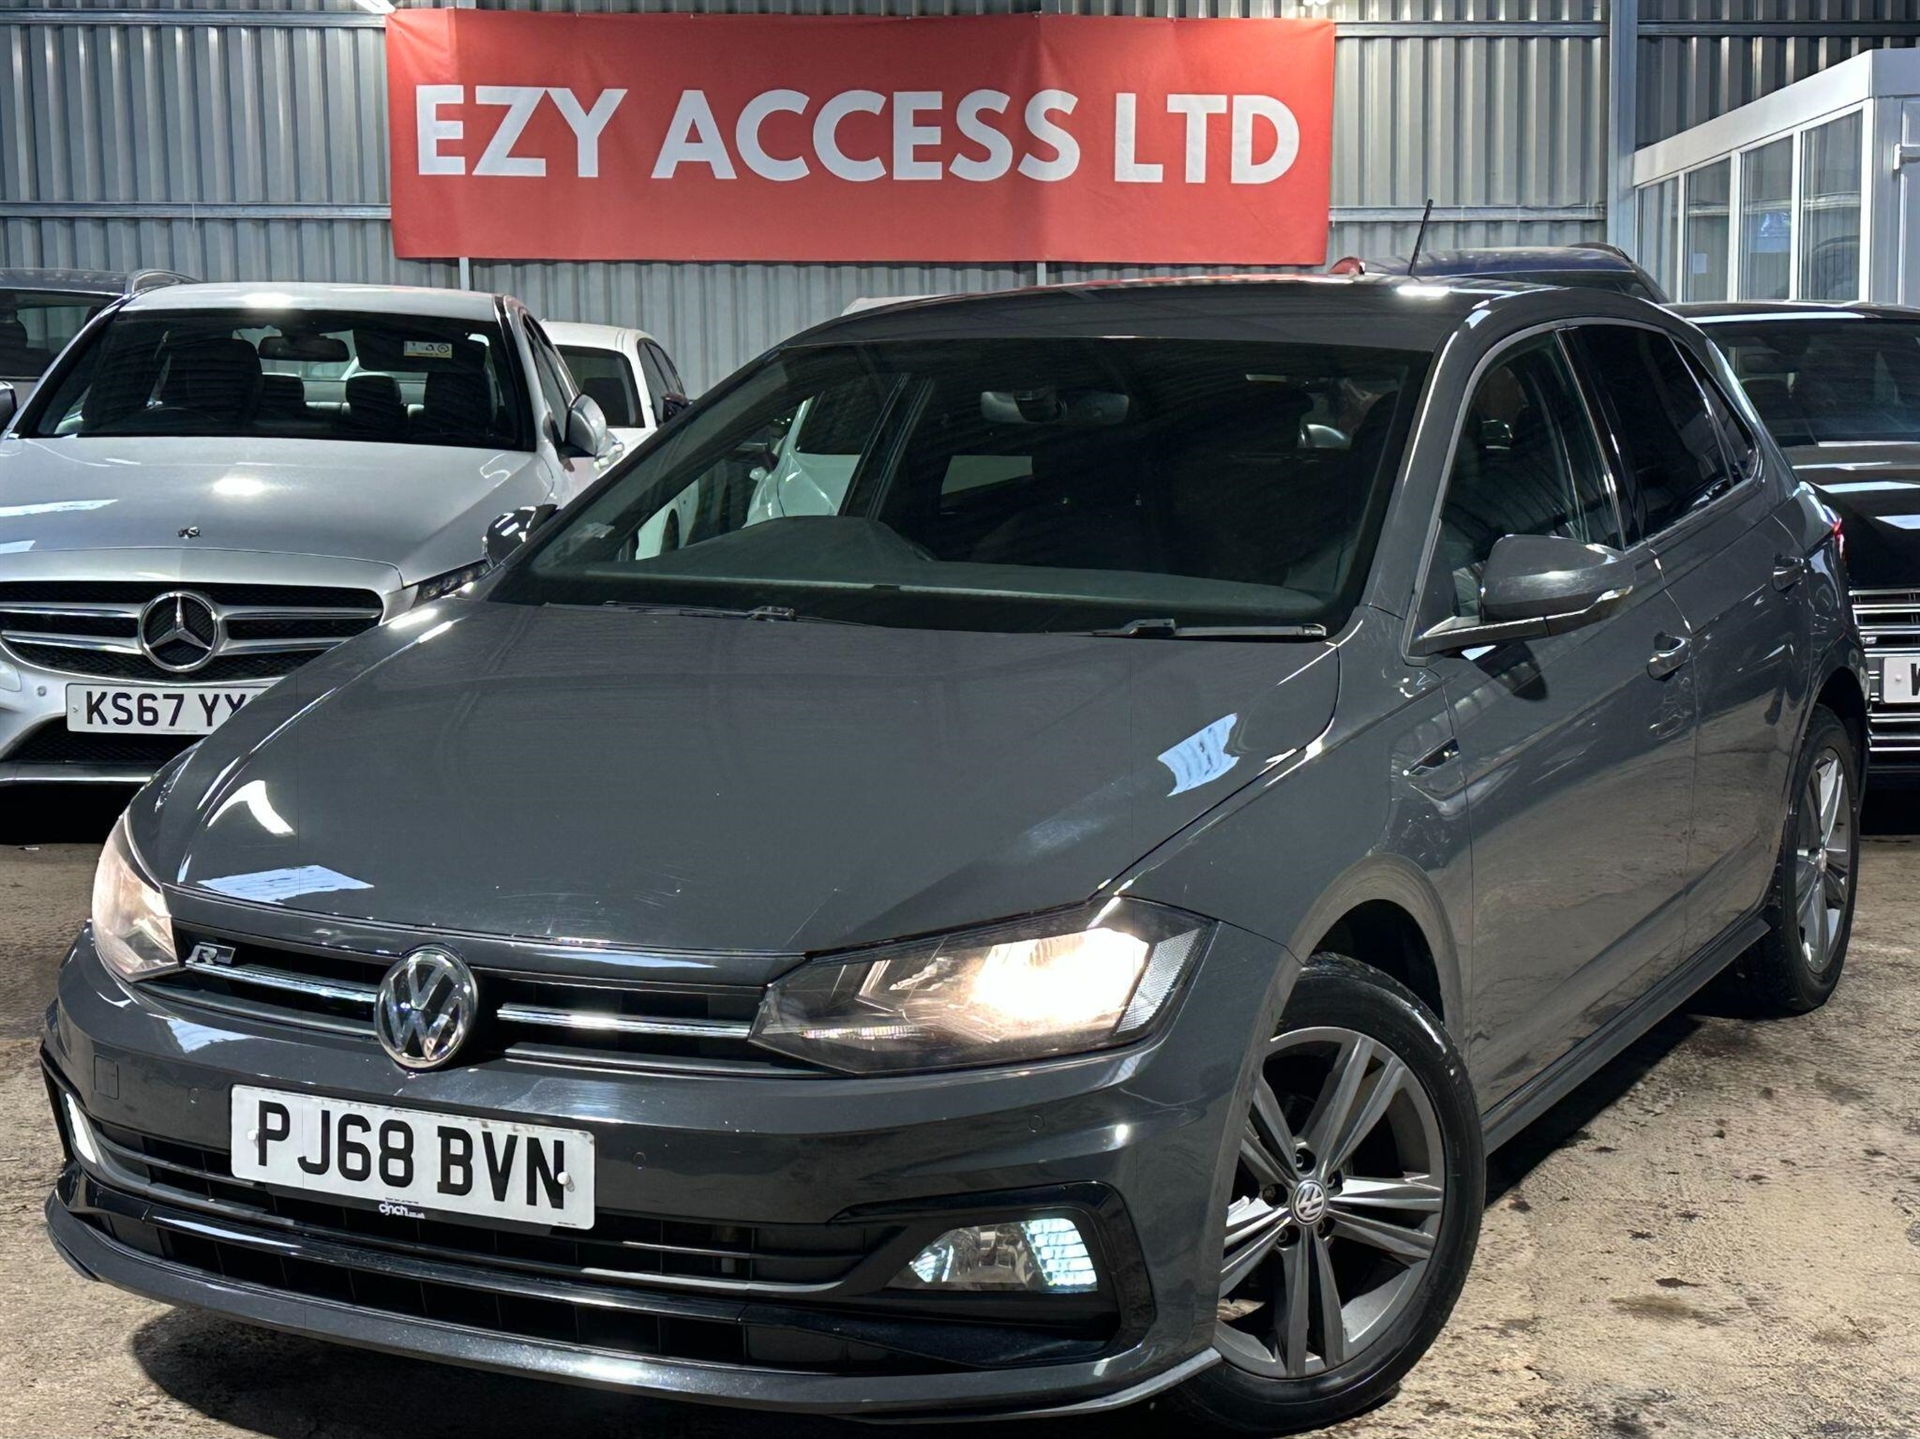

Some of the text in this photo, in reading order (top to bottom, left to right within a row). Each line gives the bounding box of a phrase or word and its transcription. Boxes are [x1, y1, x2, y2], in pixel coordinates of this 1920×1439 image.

[415, 84, 1300, 184] EZY ACCESS LTD
[86, 691, 185, 727] KS67
[258, 1099, 565, 1210] PJ68 BVN
